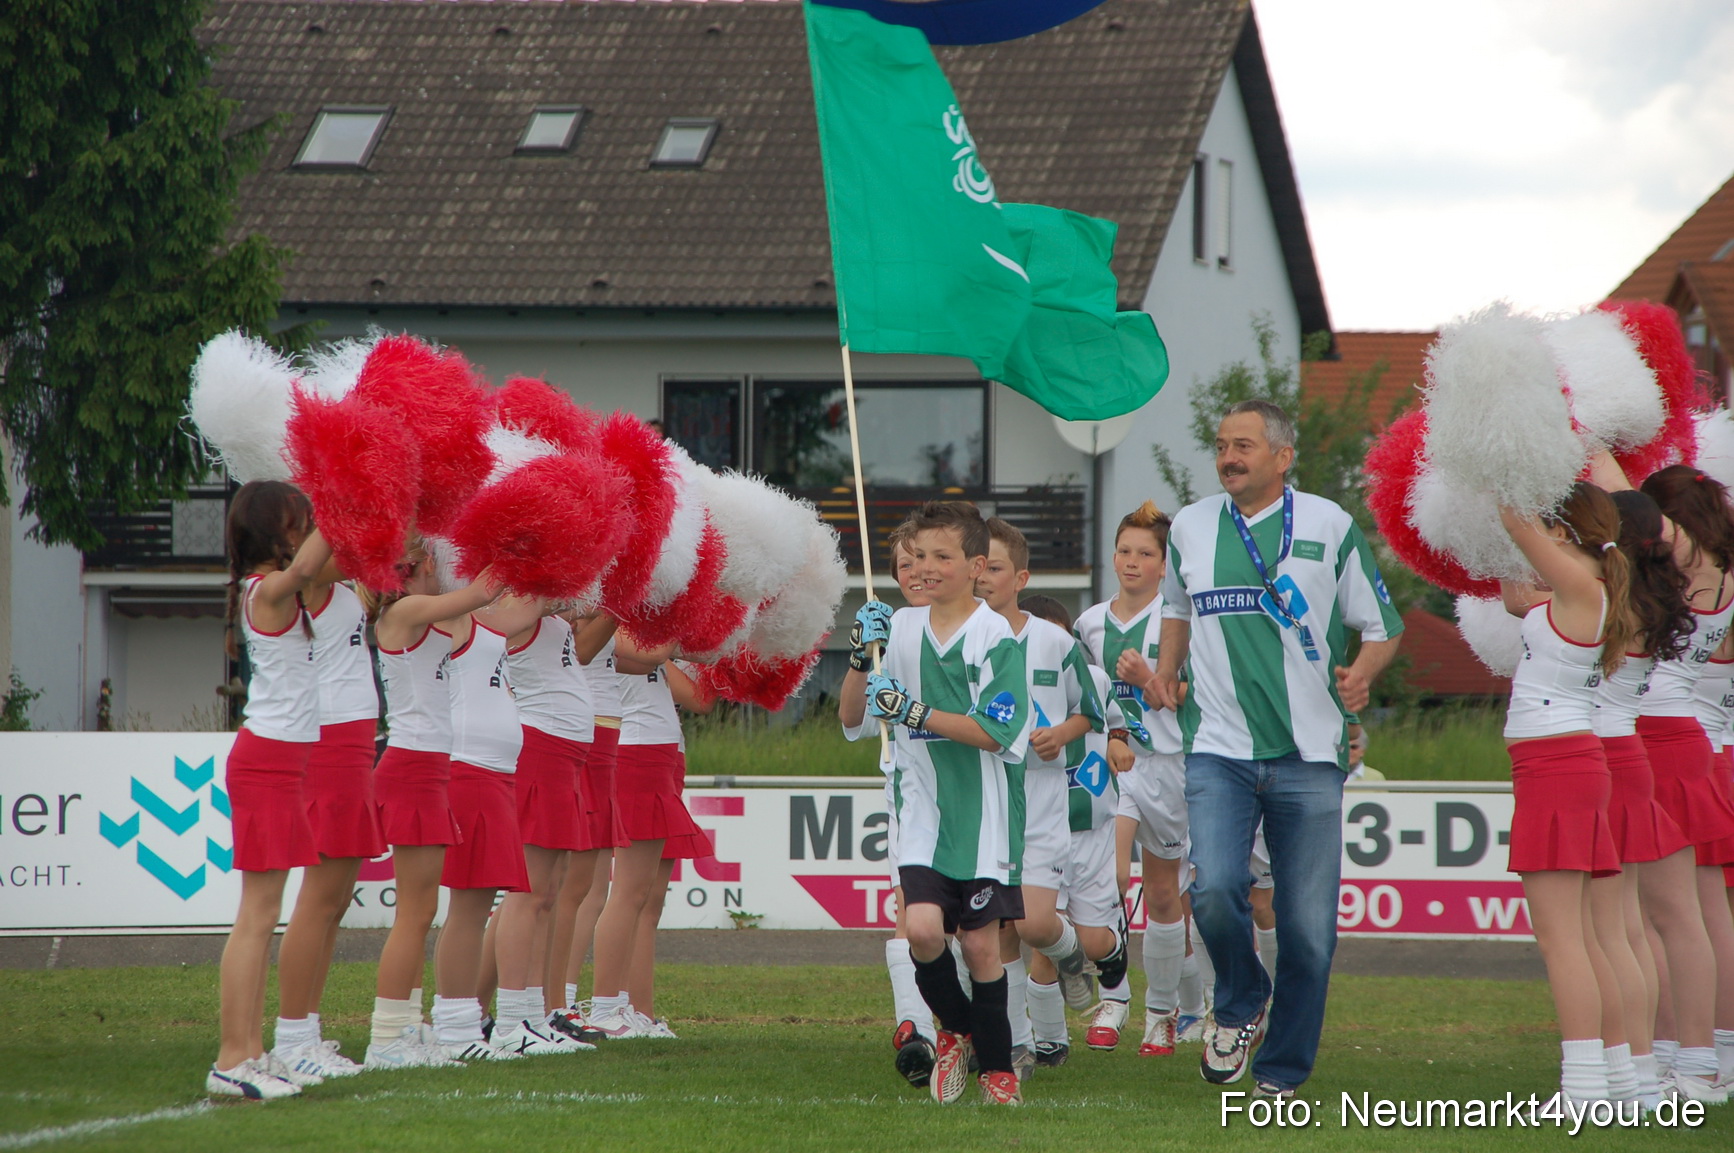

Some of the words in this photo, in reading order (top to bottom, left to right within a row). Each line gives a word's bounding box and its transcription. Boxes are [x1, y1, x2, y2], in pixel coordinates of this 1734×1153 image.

[1205, 593, 1255, 610] BAYERN
[907, 702, 926, 728] OLIVER
[1087, 761, 1100, 787] 1
[0, 793, 82, 836] er
[0, 865, 81, 887] CHT.
[667, 888, 743, 908] ON
